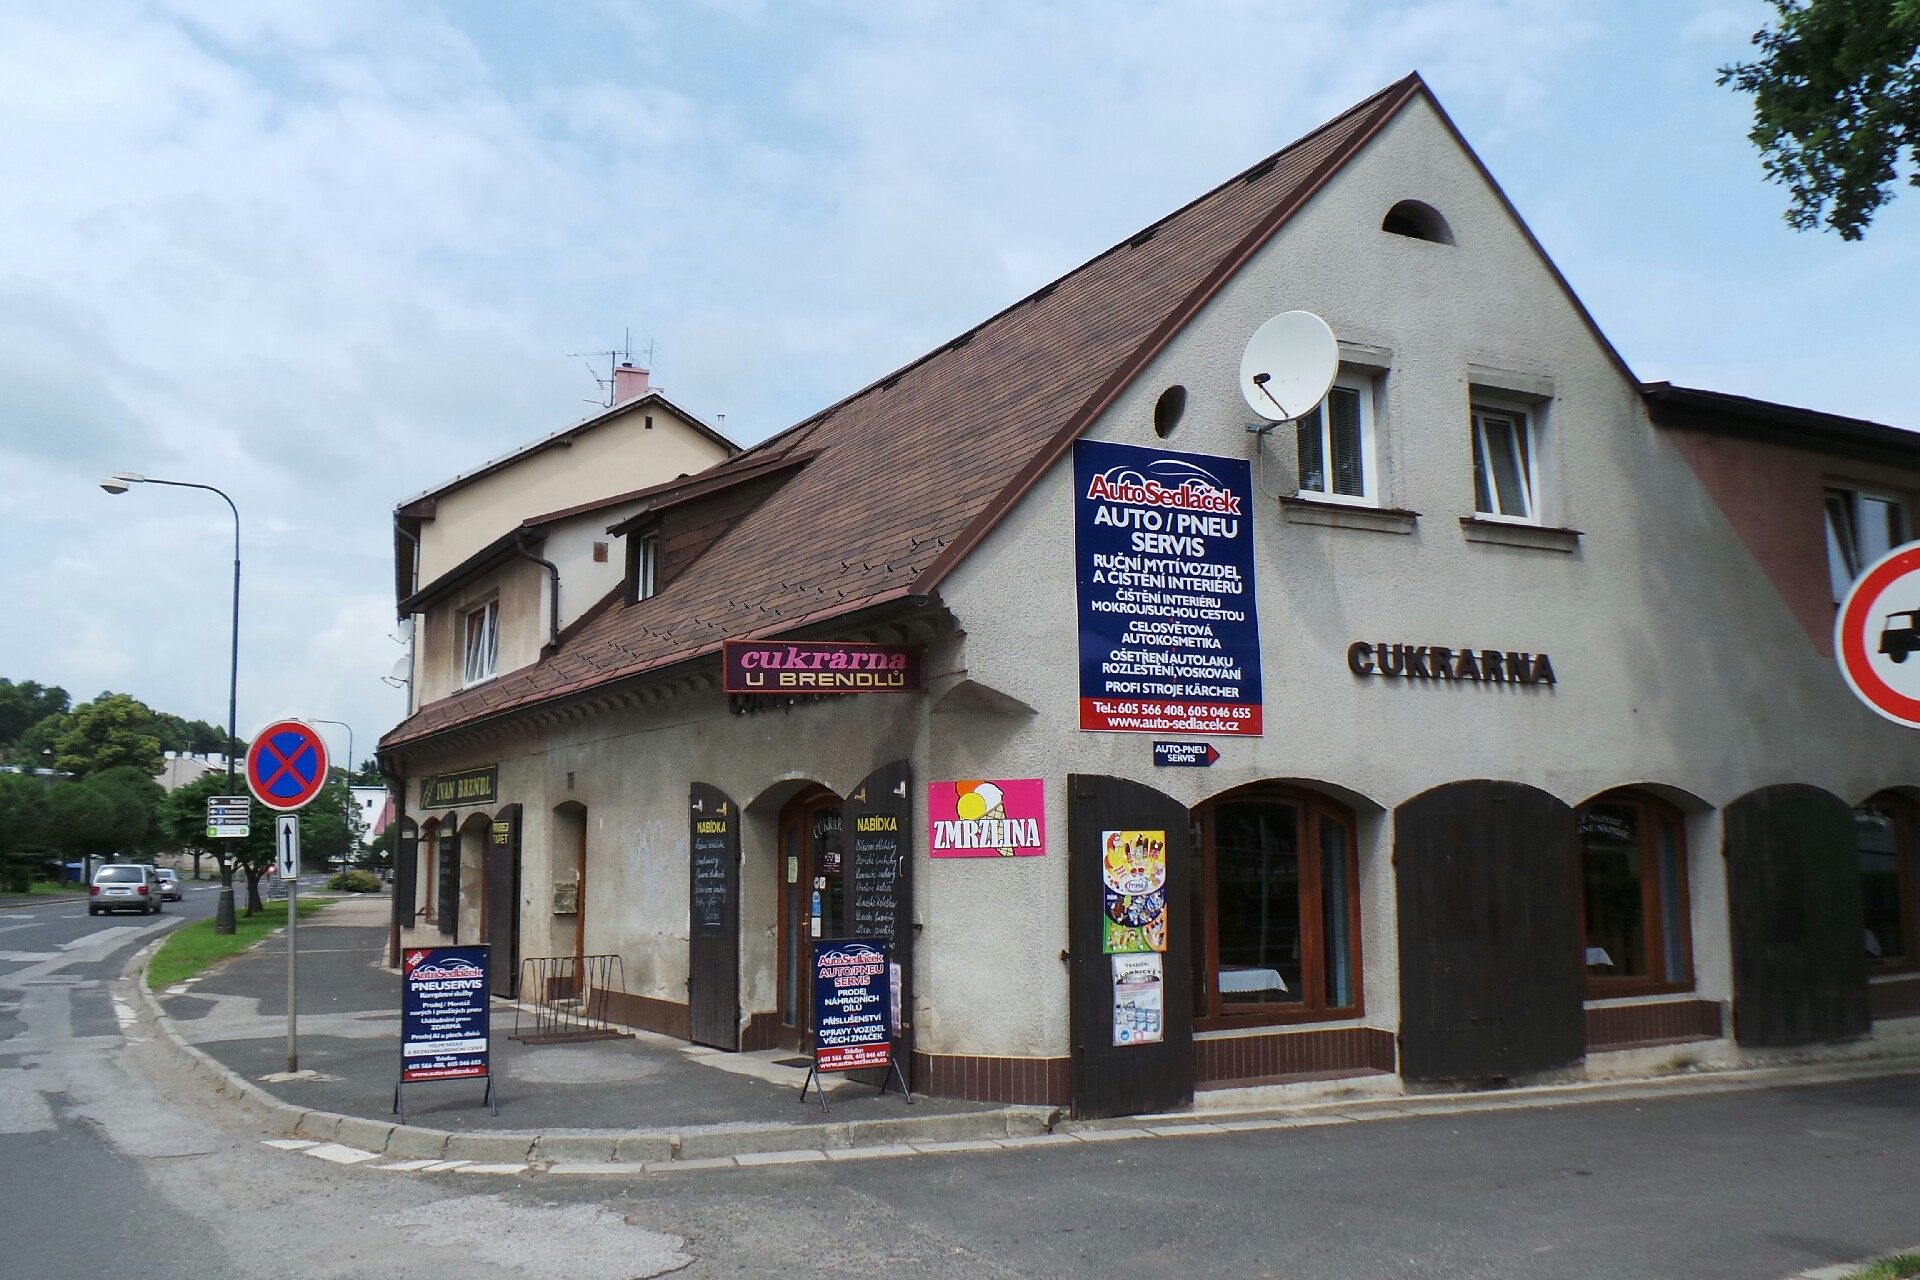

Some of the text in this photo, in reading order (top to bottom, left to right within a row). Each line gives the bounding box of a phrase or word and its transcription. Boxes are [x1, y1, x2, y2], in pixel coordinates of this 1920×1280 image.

[1088, 474, 1241, 515] AutoSedláček
[1094, 506, 1162, 531] AUTO
[1178, 513, 1237, 538] PNEU
[1131, 532, 1205, 557] SERVIS
[1094, 553, 1141, 571] RUČNÍ
[1093, 570, 1105, 583] A
[1108, 568, 1165, 588] ČIŠTĚNÍ
[1116, 587, 1220, 609] ČIŠTĚNÍ INTERIÉRU
[1201, 608, 1244, 622] CESTOU
[1129, 621, 1213, 636] CELOSVĚTOVÁ
[1122, 634, 1222, 649] AUTOKOSMETIKA
[741, 647, 907, 670] cukrárna
[746, 670, 904, 686] U BRENDLŮ
[1106, 681, 1239, 698] PROFI STROJE KÄRCHER
[1142, 704, 1160, 715] 566
[1210, 707, 1229, 718] 046
[1232, 708, 1251, 719] 655
[1108, 717, 1239, 731] www.auto-sedlacek.cz
[1155, 744, 1206, 754] AUTO-PNEU
[1168, 754, 1195, 763] SERVIS
[437, 776, 491, 800] IVAN BRENDL
[697, 820, 726, 833] NABÍDKA
[858, 815, 898, 832] NABÍDKA
[934, 818, 1041, 849] ZMRZLINA
[412, 980, 483, 991] PNEUSERVIS
[834, 976, 870, 987] SERVIS
[838, 988, 866, 996] PRODEJ
[825, 995, 879, 1006] NÁHRADNÍCH
[823, 1013, 881, 1025] PŘÍSLUŠENSTVÍ
[820, 1025, 886, 1037] OPRAVY VOZIDEL
[823, 1032, 883, 1045] VŠECH ZNAČEK
